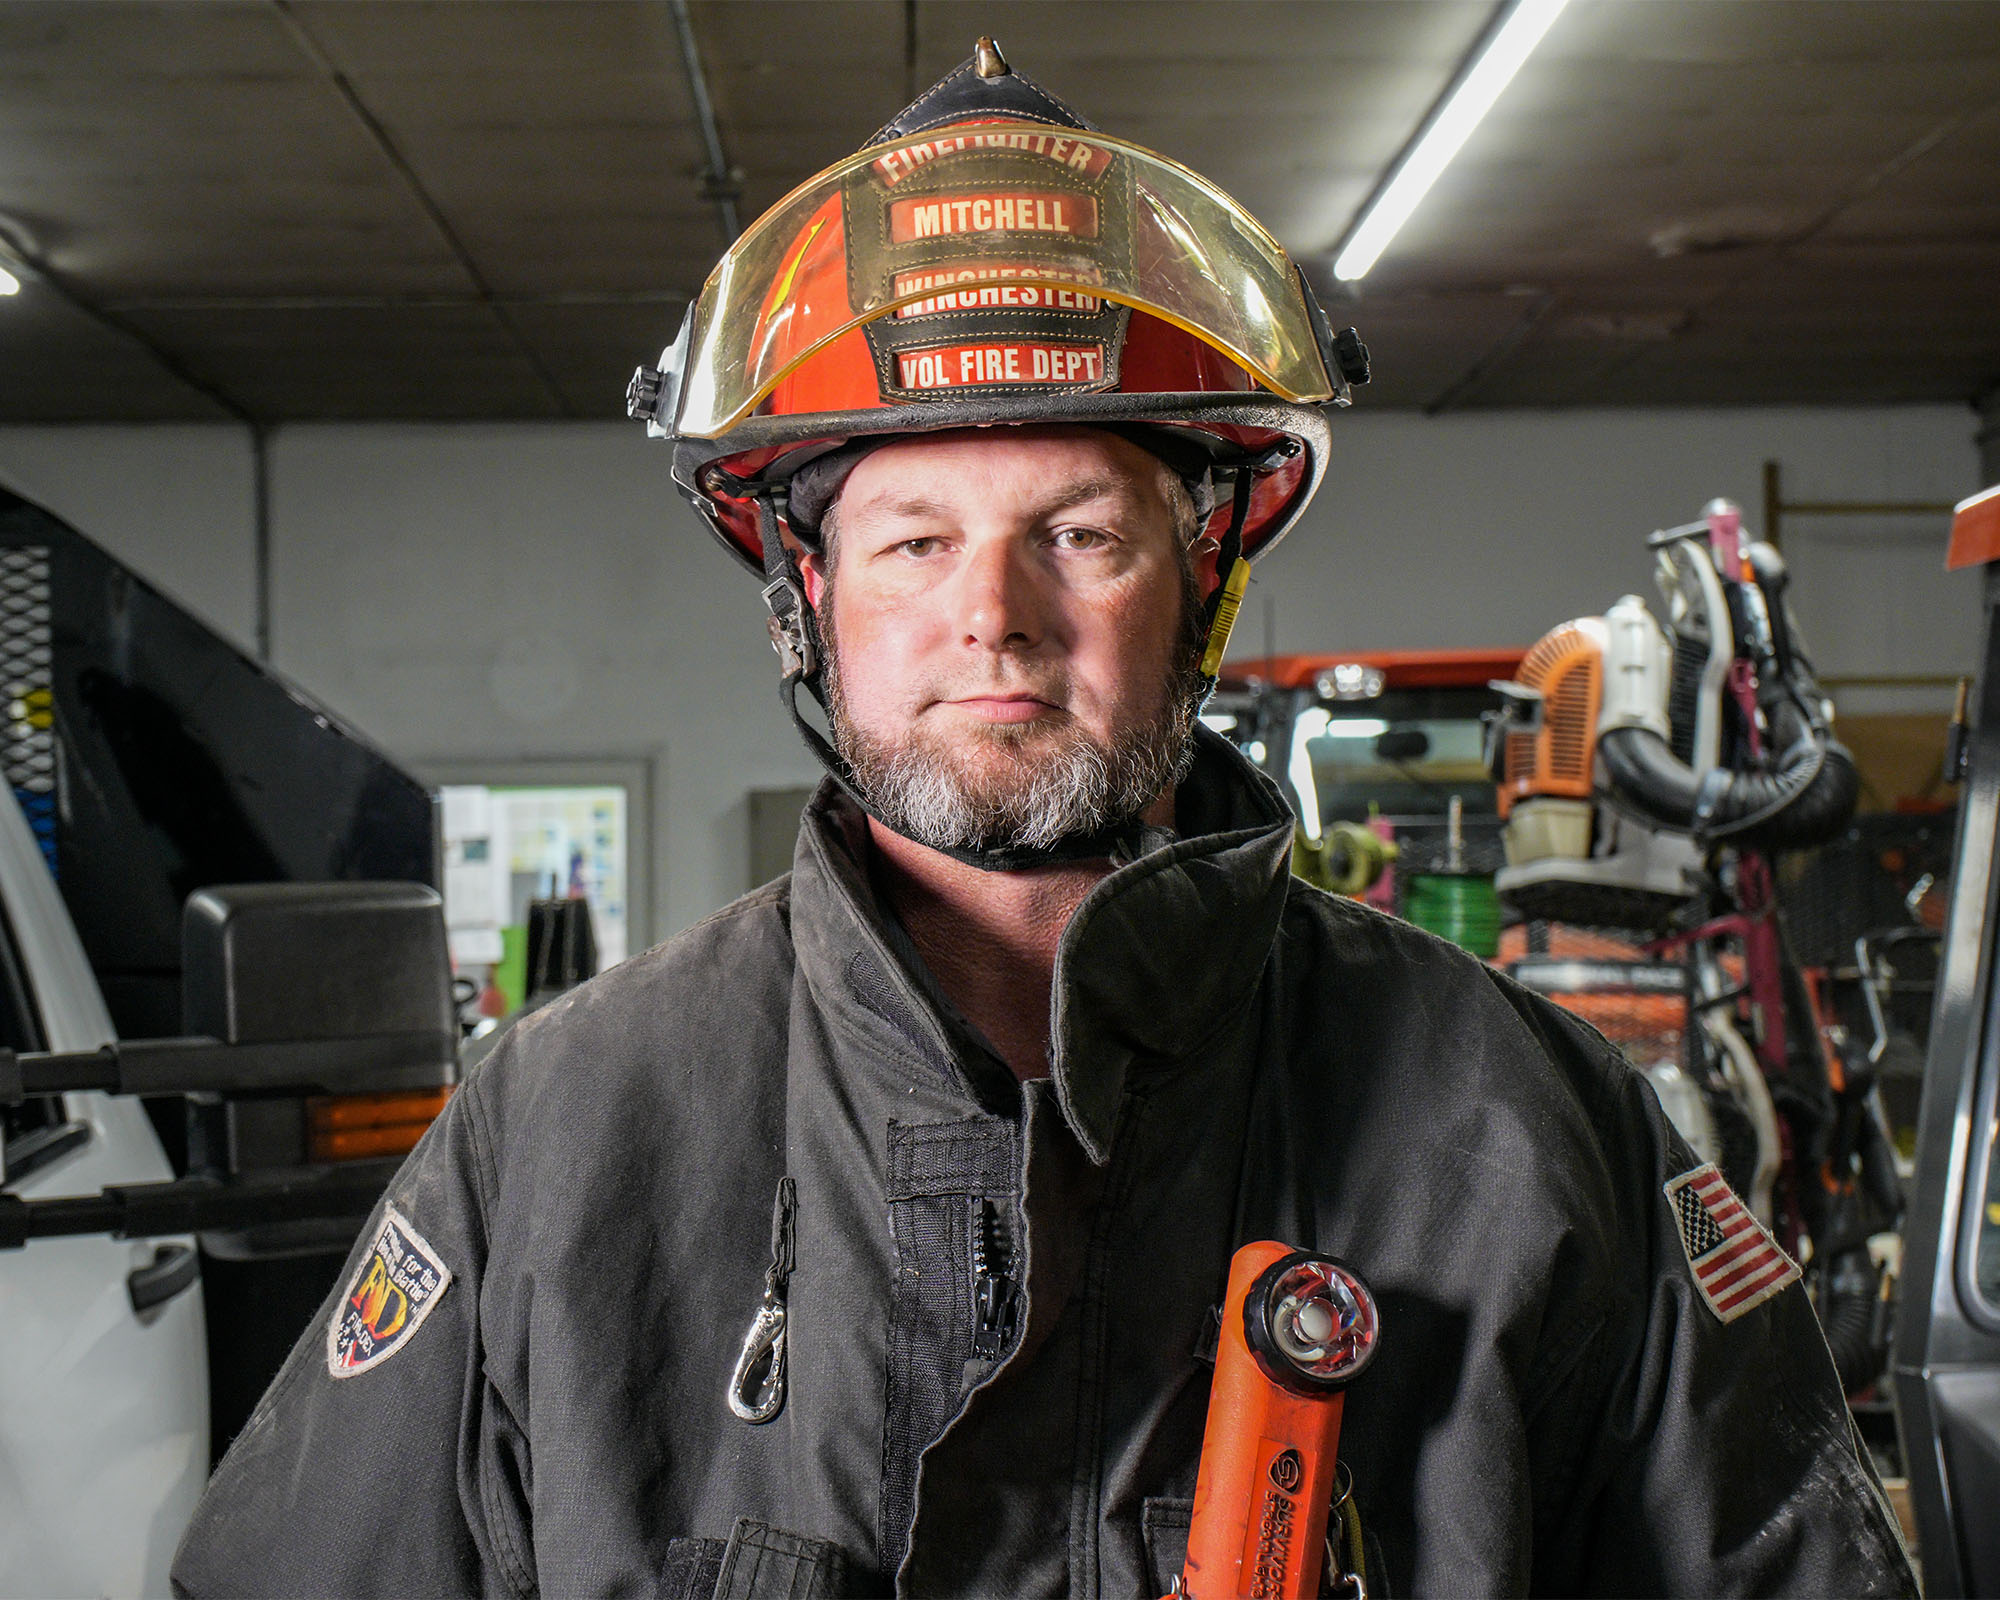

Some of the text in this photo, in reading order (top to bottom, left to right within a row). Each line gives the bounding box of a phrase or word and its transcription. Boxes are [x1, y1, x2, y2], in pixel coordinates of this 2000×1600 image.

[914, 199, 1070, 238] MITCHELL
[897, 269, 1094, 317] WINCHESTER
[902, 348, 1097, 389] VOL FIRE DEPT
